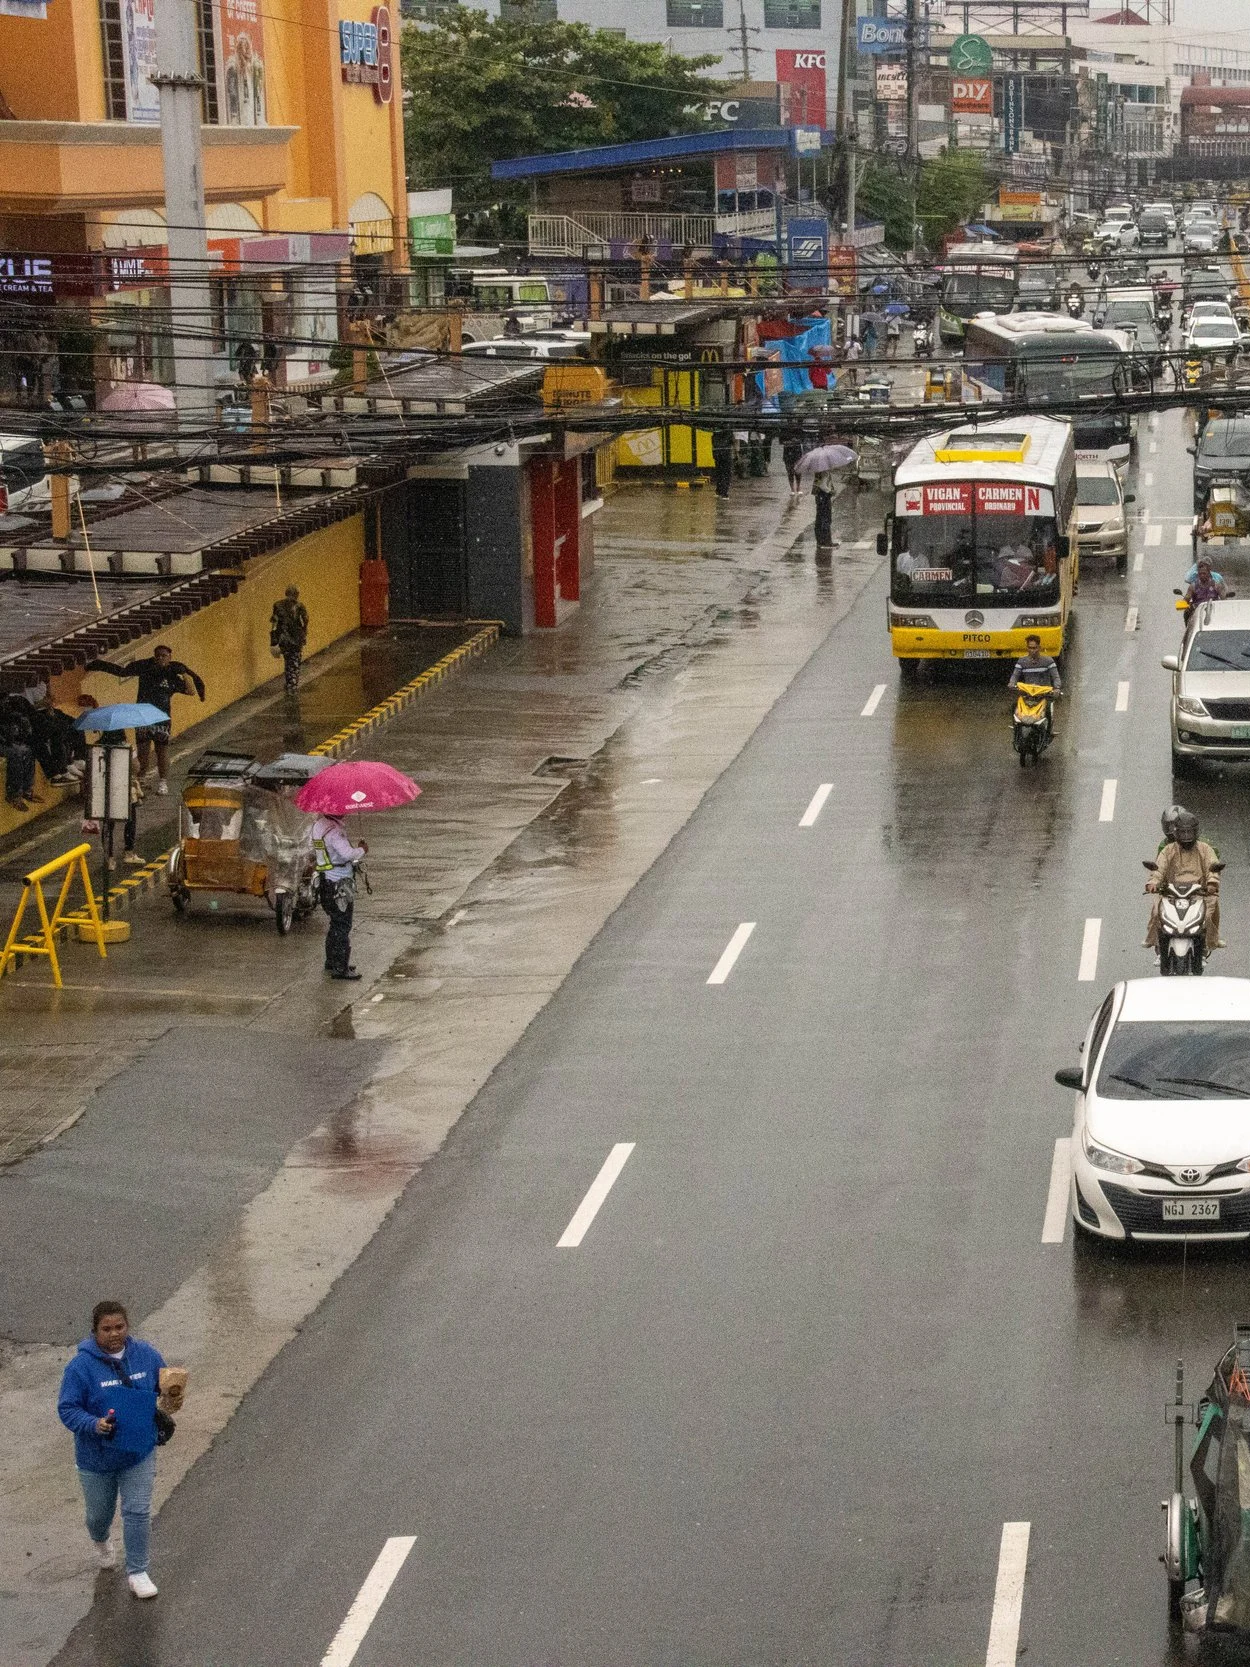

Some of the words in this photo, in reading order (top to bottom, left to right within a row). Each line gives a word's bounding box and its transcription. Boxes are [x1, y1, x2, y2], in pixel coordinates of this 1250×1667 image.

[341, 20, 379, 67] SUPER
[794, 53, 826, 69] KFC
[678, 353, 692, 361] go!
[926, 488, 961, 500] VIGAN
[978, 487, 1022, 501] CARMEN
[1027, 488, 1040, 511] N
[929, 502, 966, 511] PROVINCIAL
[912, 571, 951, 582] CARMEN
[962, 634, 991, 643] PITCO
[1164, 1204, 1184, 1215] NGJ
[1191, 1204, 1217, 1216] 2367
